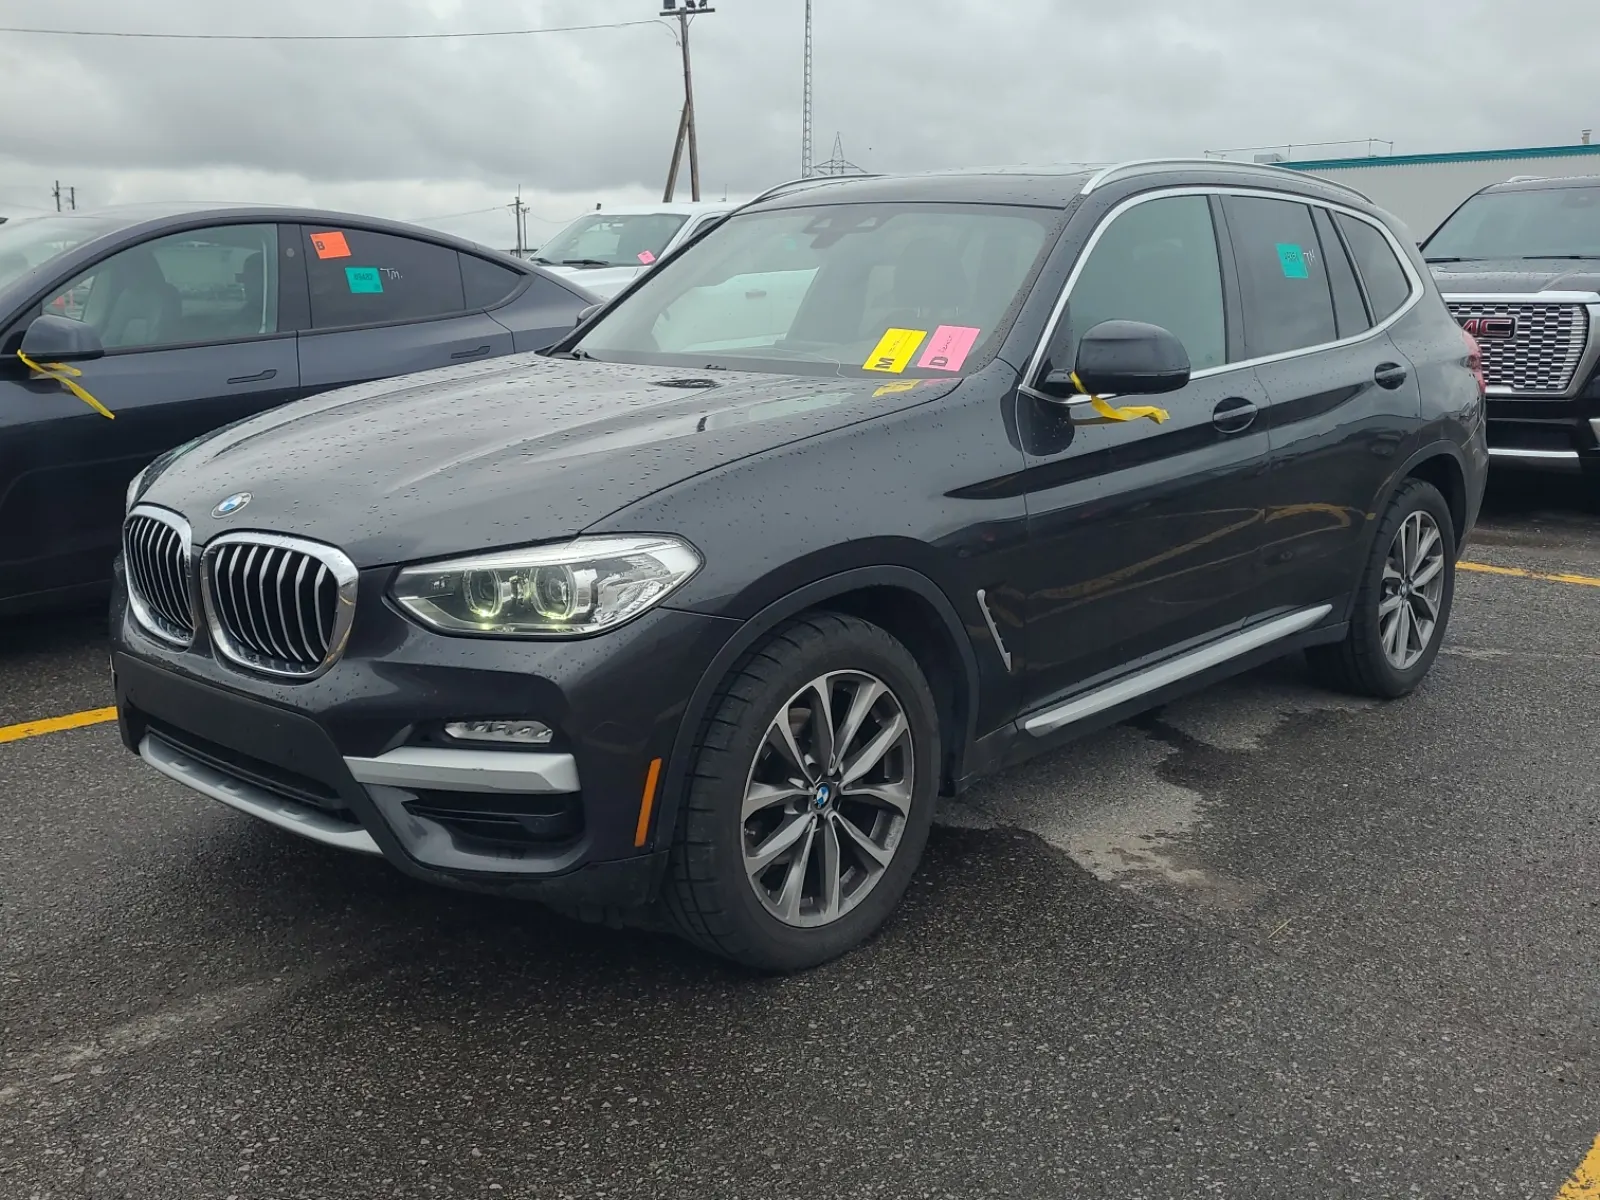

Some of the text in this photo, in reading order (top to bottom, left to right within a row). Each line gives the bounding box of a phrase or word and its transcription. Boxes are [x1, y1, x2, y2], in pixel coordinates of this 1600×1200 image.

[315, 240, 325, 251] B
[874, 357, 896, 369] M
[929, 356, 949, 367] D
